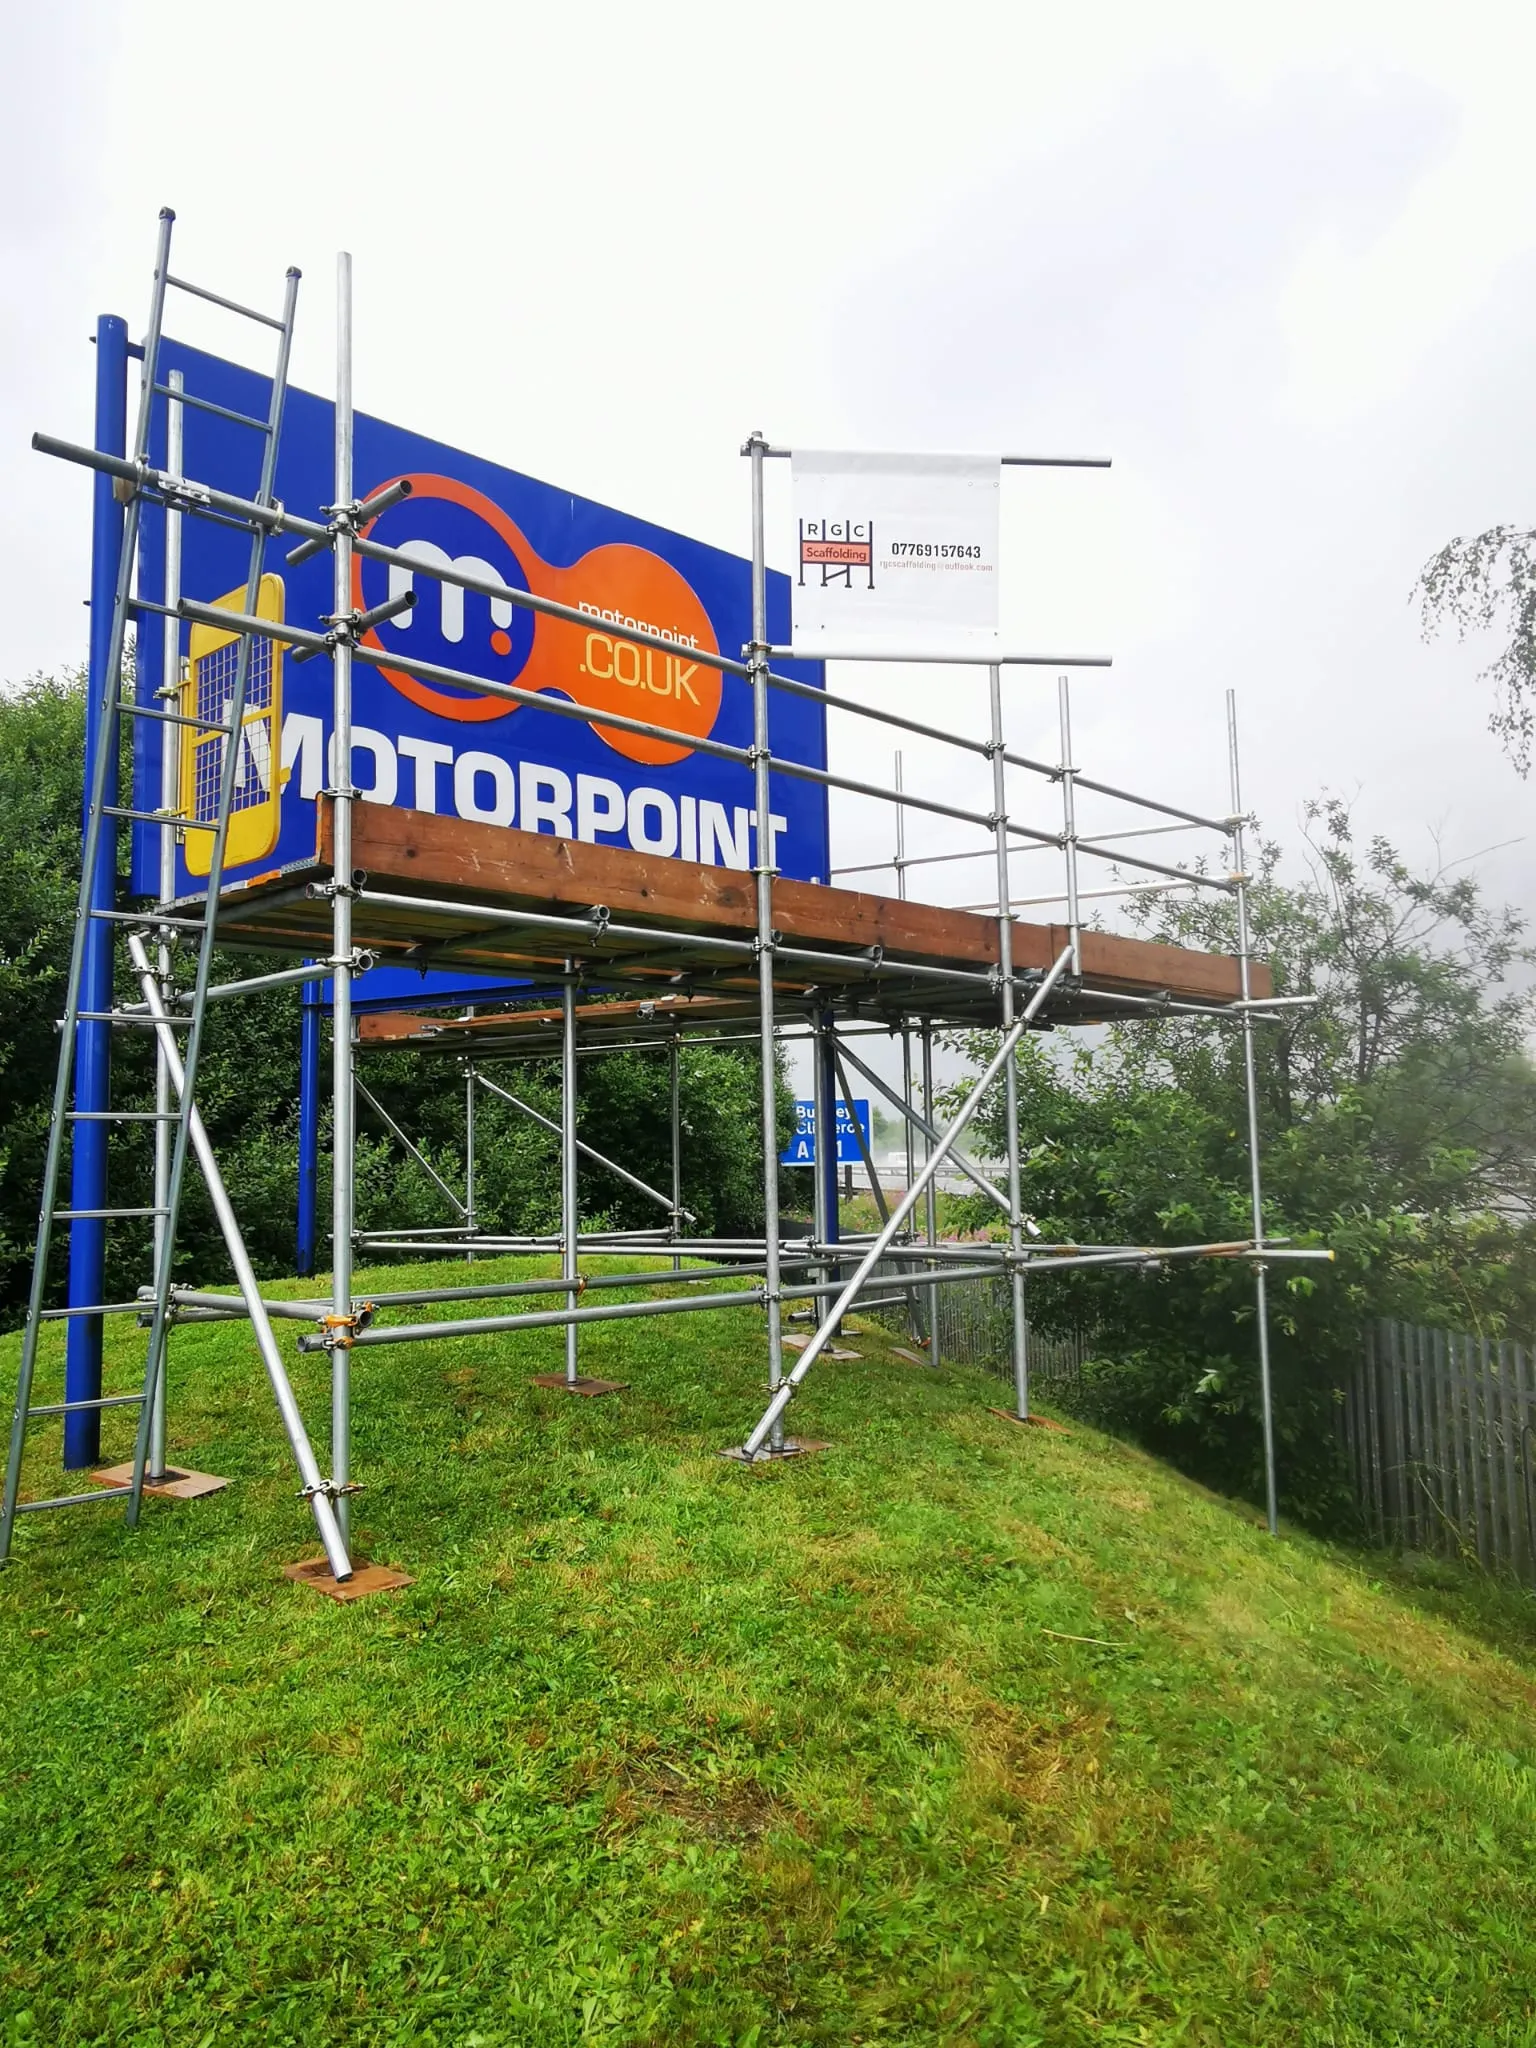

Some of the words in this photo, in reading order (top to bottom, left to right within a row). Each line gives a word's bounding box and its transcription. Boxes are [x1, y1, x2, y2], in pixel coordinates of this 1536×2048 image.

[806, 547, 867, 562] Scaffolding
[891, 542, 981, 559] 07769157643
[579, 632, 701, 706] .CO.UK
[221, 698, 788, 873] MOTORPOINT
[795, 1105, 852, 1120] Buey
[795, 1120, 866, 1136] Cliero
[796, 1140, 843, 1159] A1
